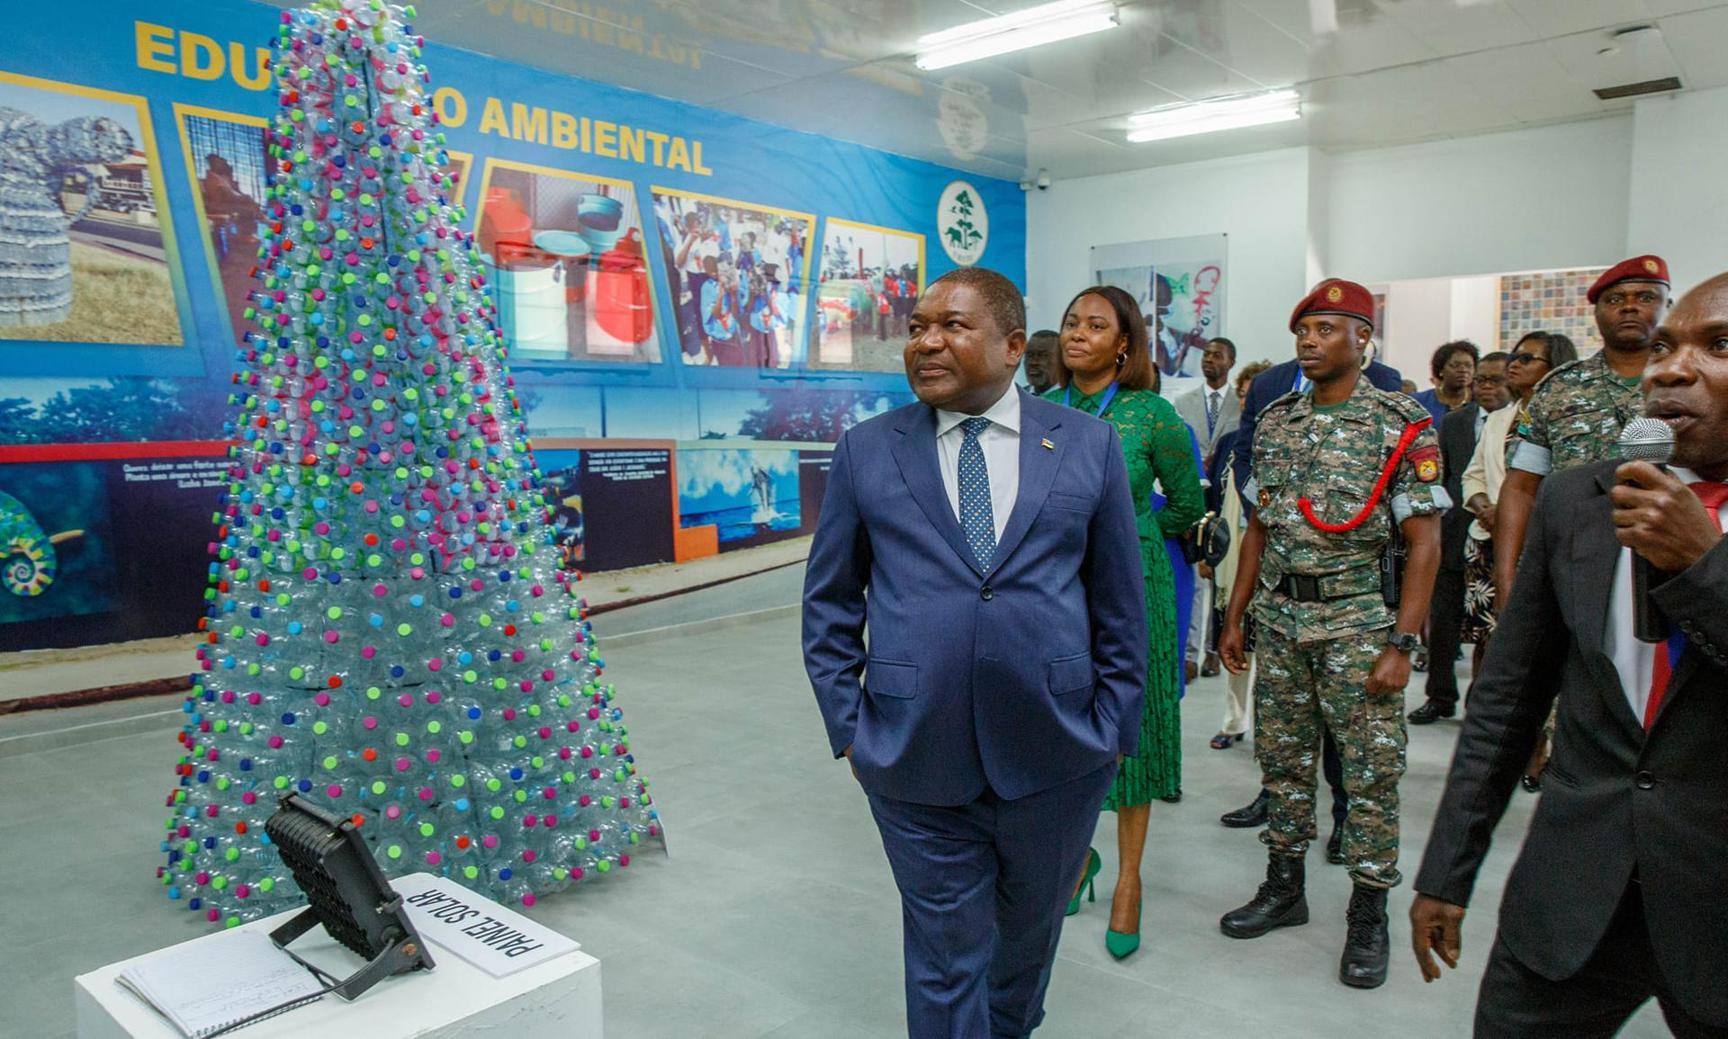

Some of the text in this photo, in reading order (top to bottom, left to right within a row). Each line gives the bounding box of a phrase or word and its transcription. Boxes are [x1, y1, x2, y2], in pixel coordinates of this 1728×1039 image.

[135, 20, 713, 176] EDUO AMBIENTAL
[406, 889, 544, 958] PAINEL SOLAR
